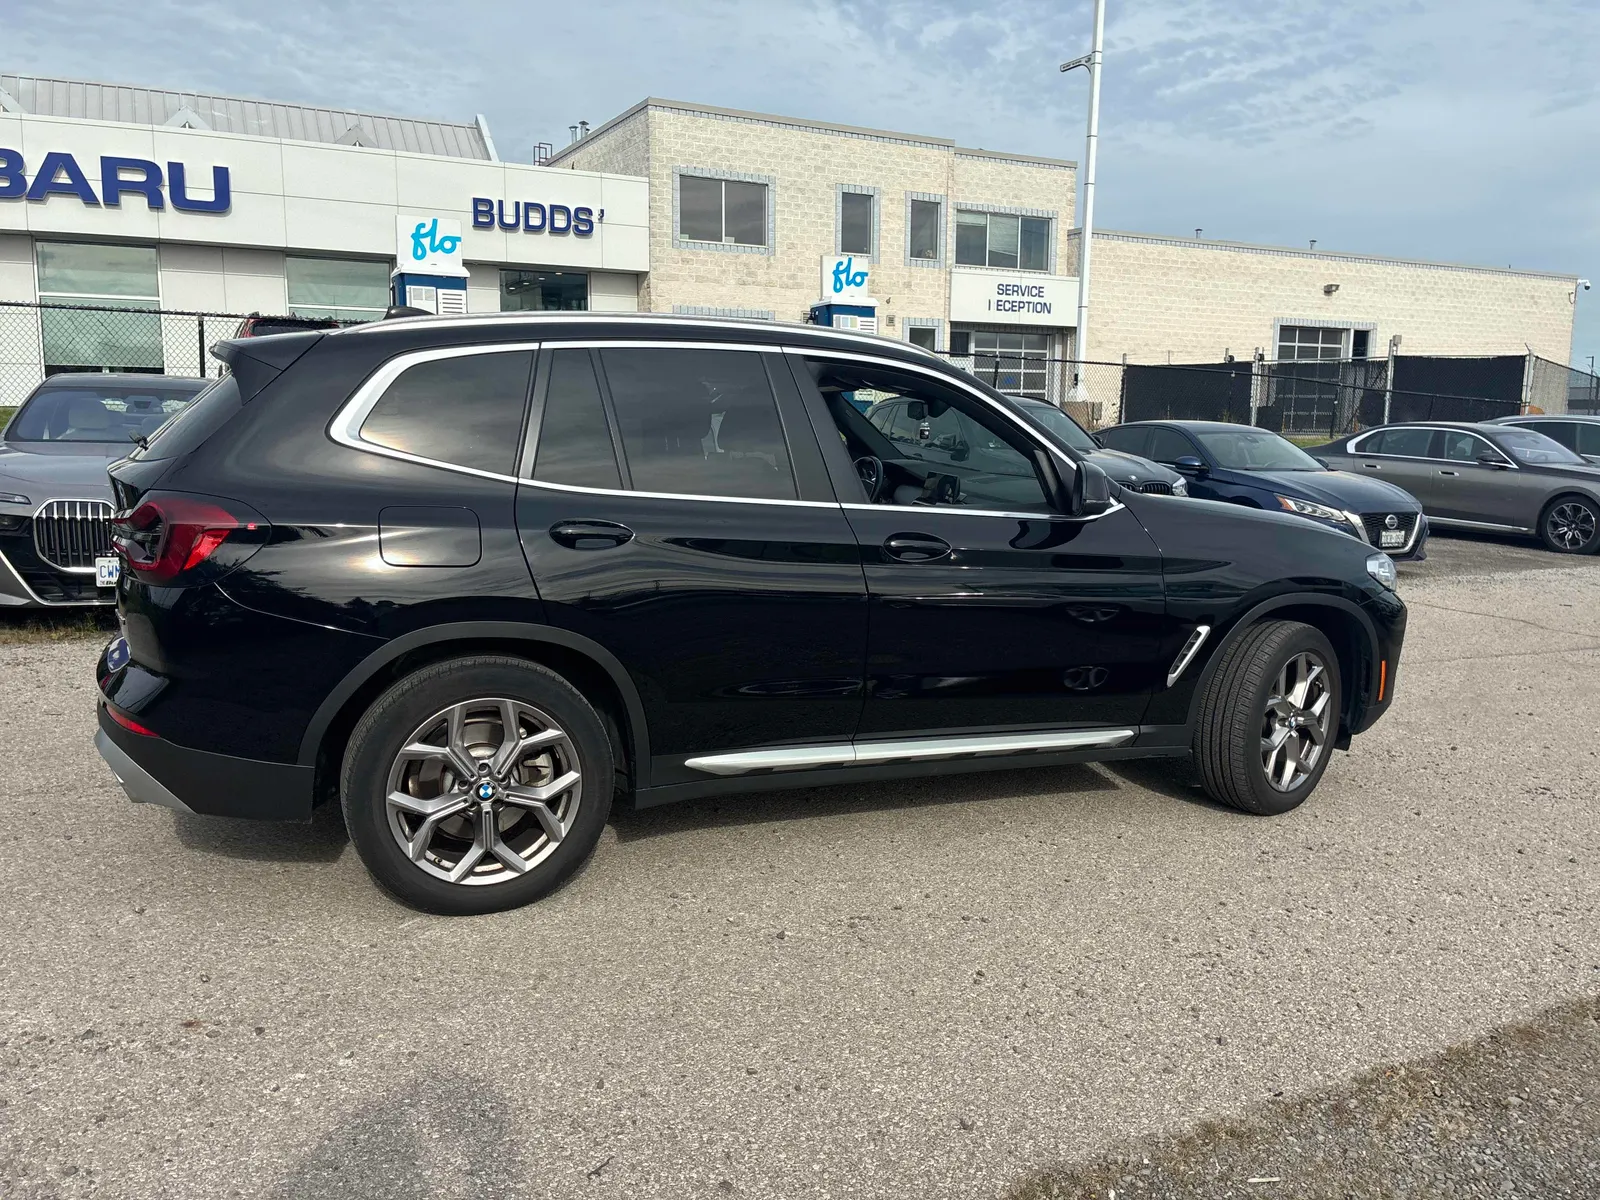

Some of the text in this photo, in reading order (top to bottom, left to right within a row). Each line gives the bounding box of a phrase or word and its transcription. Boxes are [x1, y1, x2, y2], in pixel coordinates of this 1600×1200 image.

[410, 218, 462, 260] flo
[832, 257, 868, 293] flo
[997, 283, 1045, 298] SERVICE
[988, 298, 1052, 314] ECEPTION
